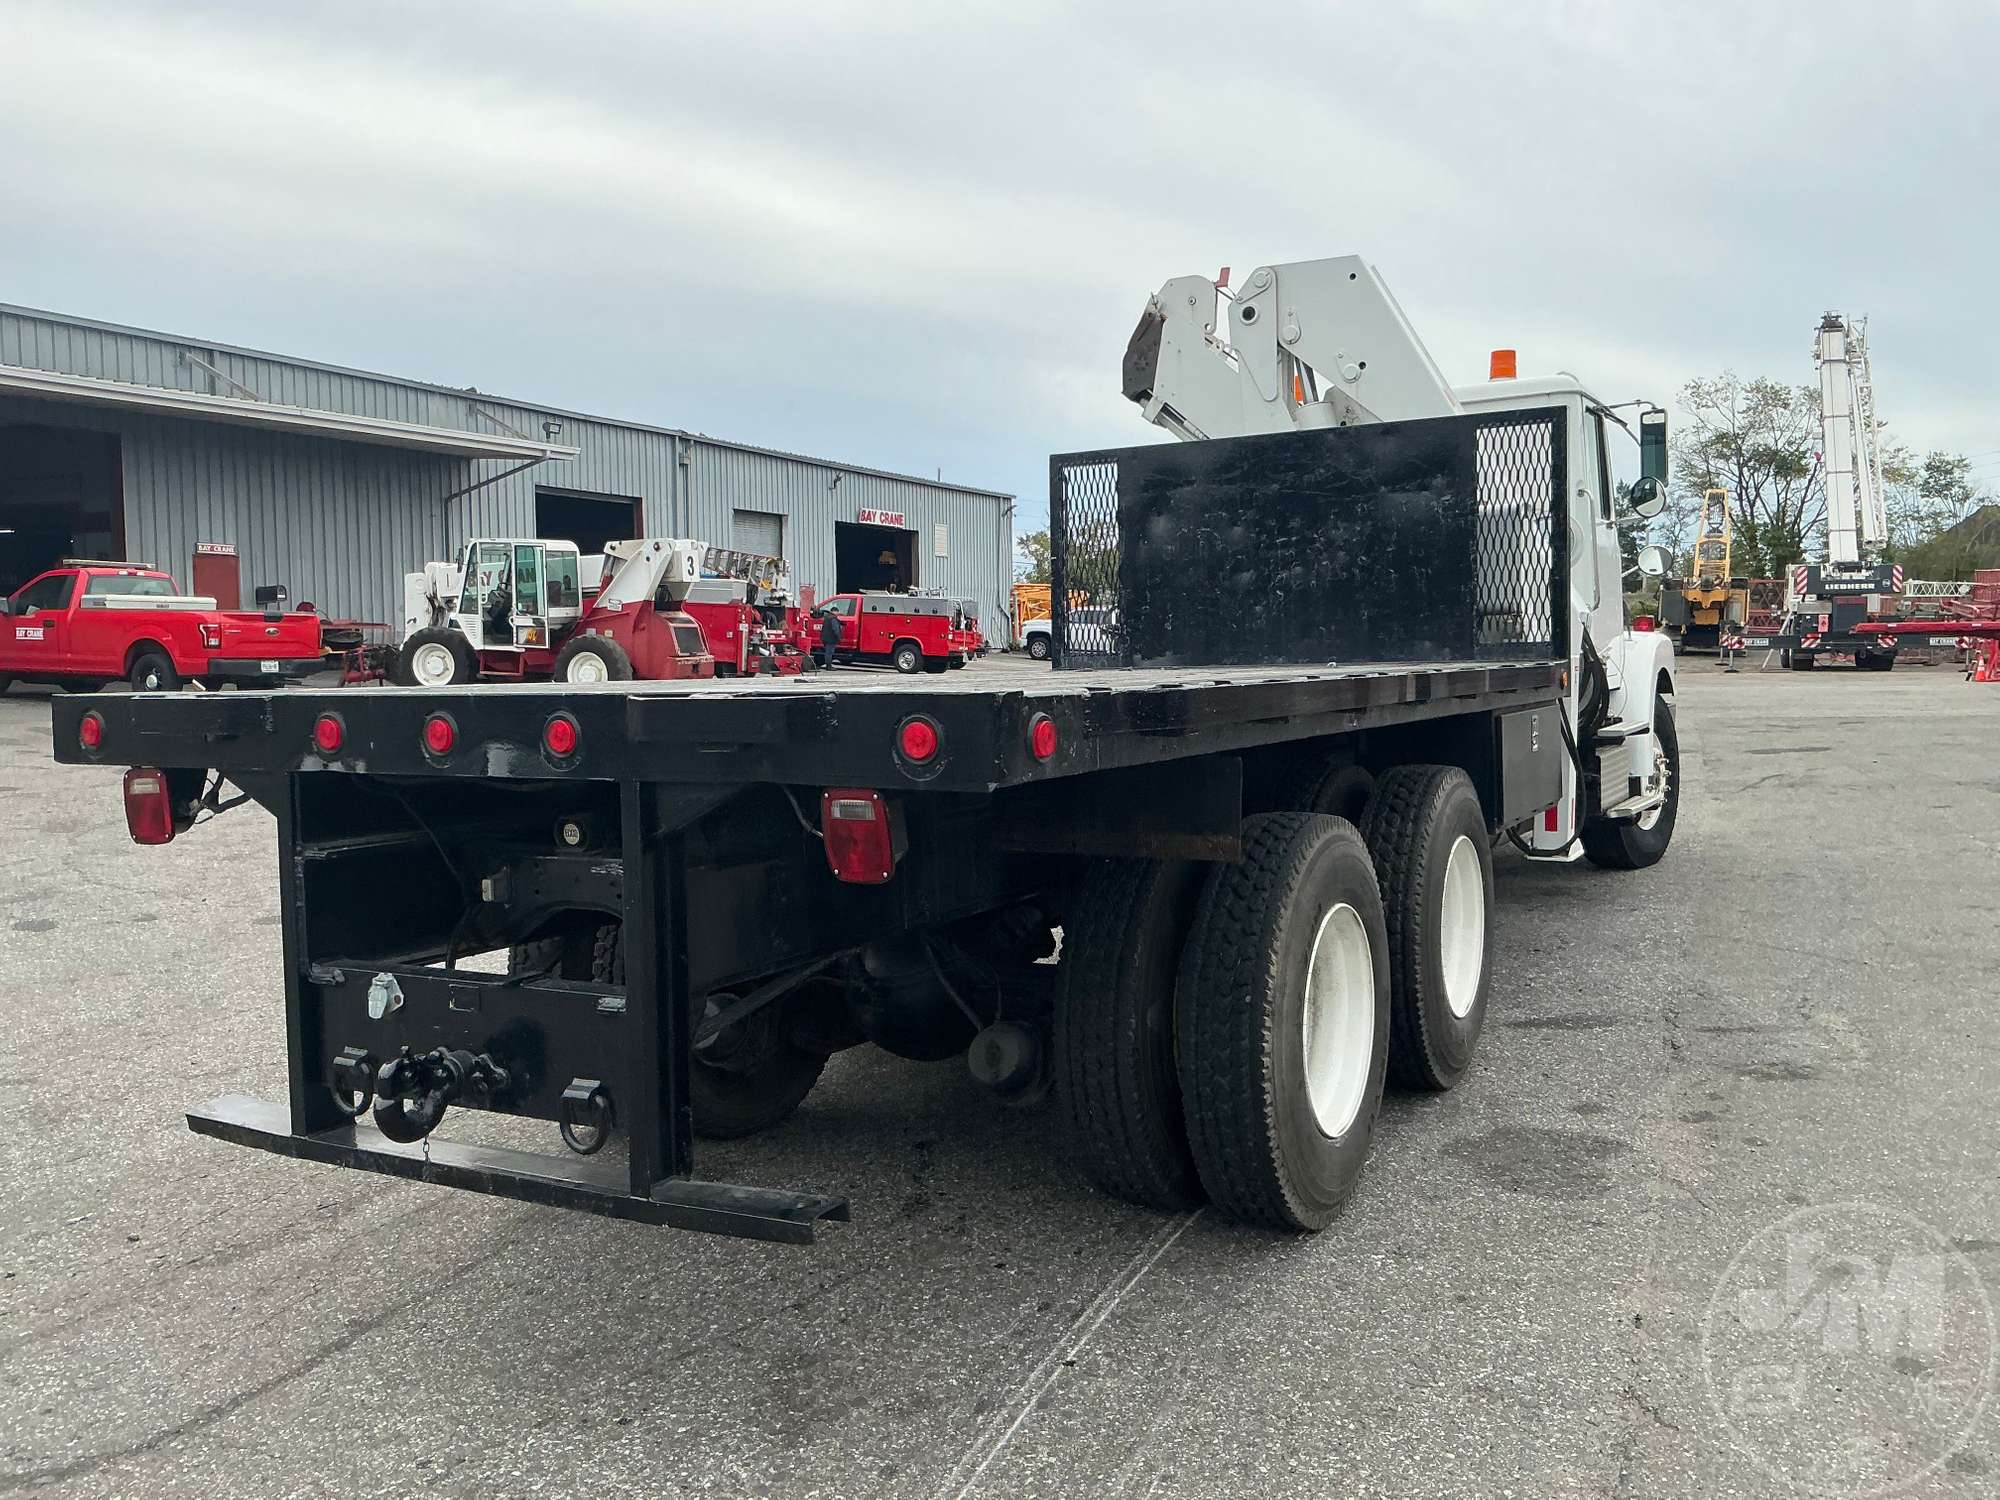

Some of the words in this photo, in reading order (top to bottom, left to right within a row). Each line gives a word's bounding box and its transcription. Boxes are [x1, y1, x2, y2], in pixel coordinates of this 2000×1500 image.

[860, 509, 877, 522] BAY
[879, 511, 904, 526] CRANE
[687, 555, 695, 576] 3
